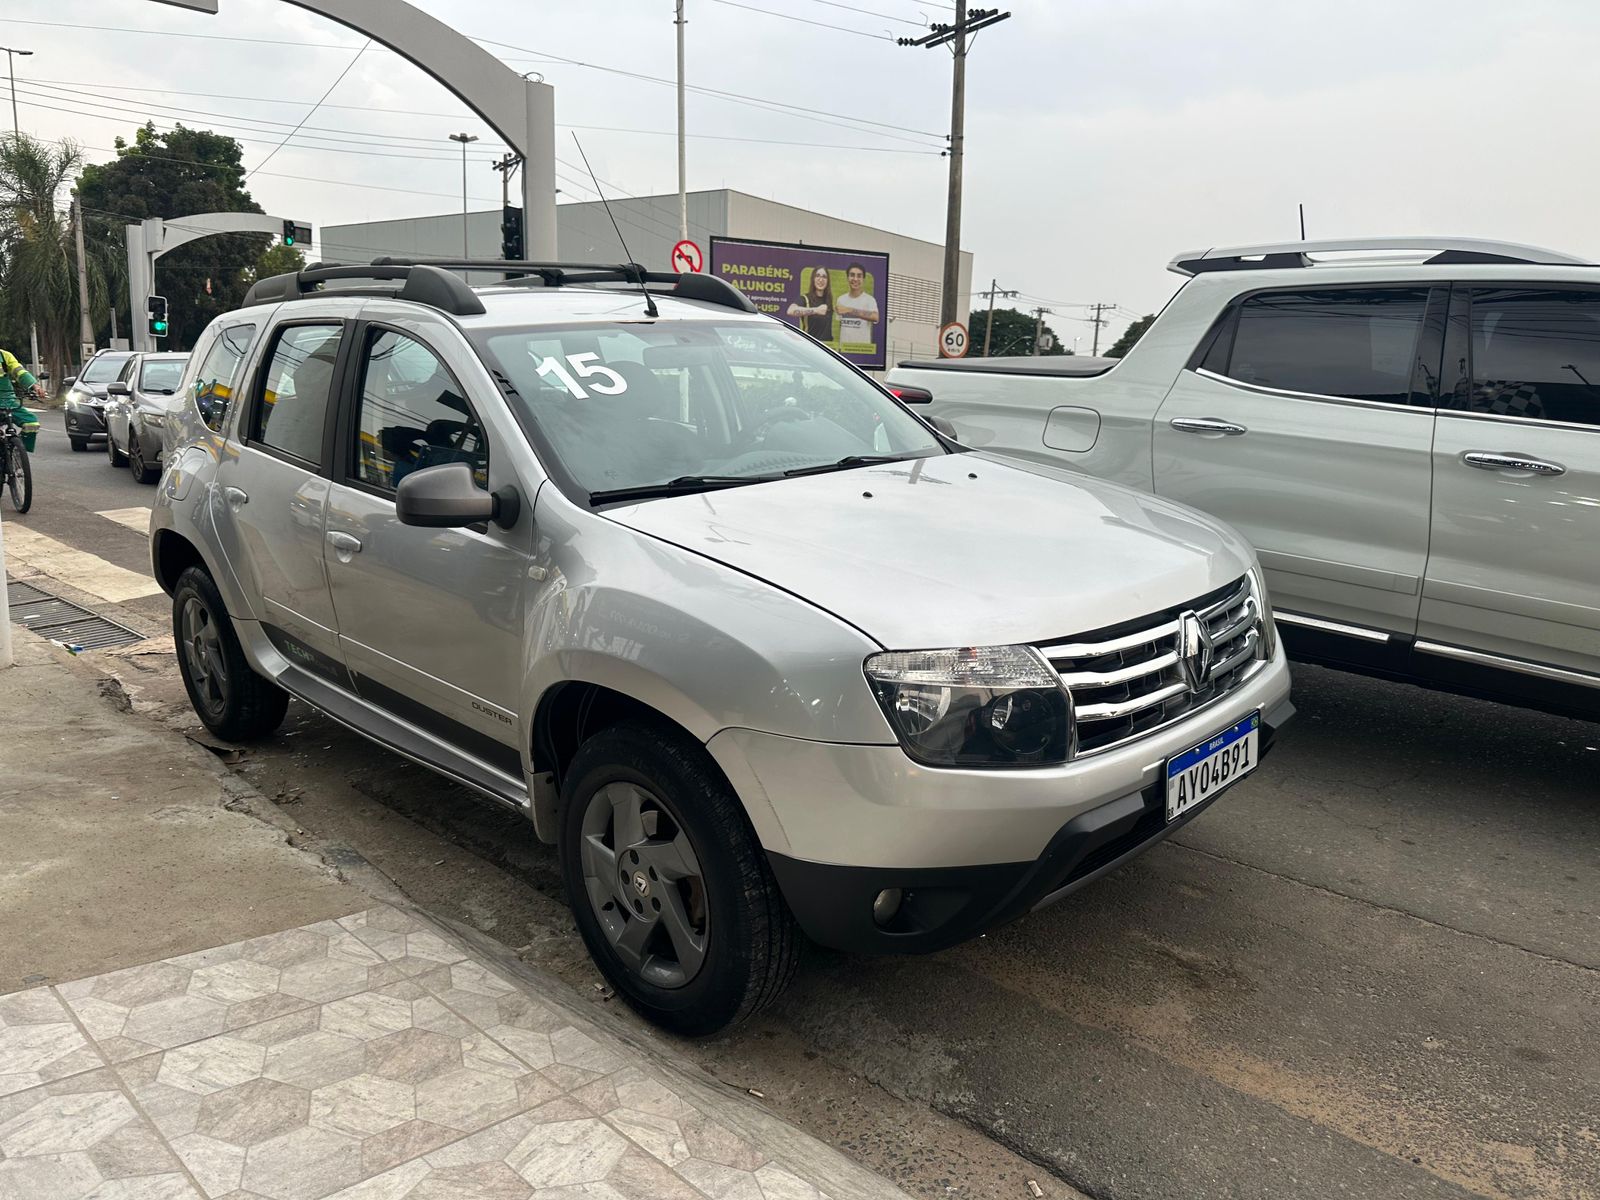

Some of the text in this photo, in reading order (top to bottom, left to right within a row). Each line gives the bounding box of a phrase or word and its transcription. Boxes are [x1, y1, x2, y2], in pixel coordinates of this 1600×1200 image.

[722, 264, 793, 280] PARABÉNS,
[731, 280, 785, 293] ALUNOS!
[945, 332, 964, 347] 60
[535, 352, 628, 400] 15
[471, 701, 513, 726] DUSTER
[1209, 737, 1224, 751] BRASIL
[1177, 736, 1250, 810] AY04B91
